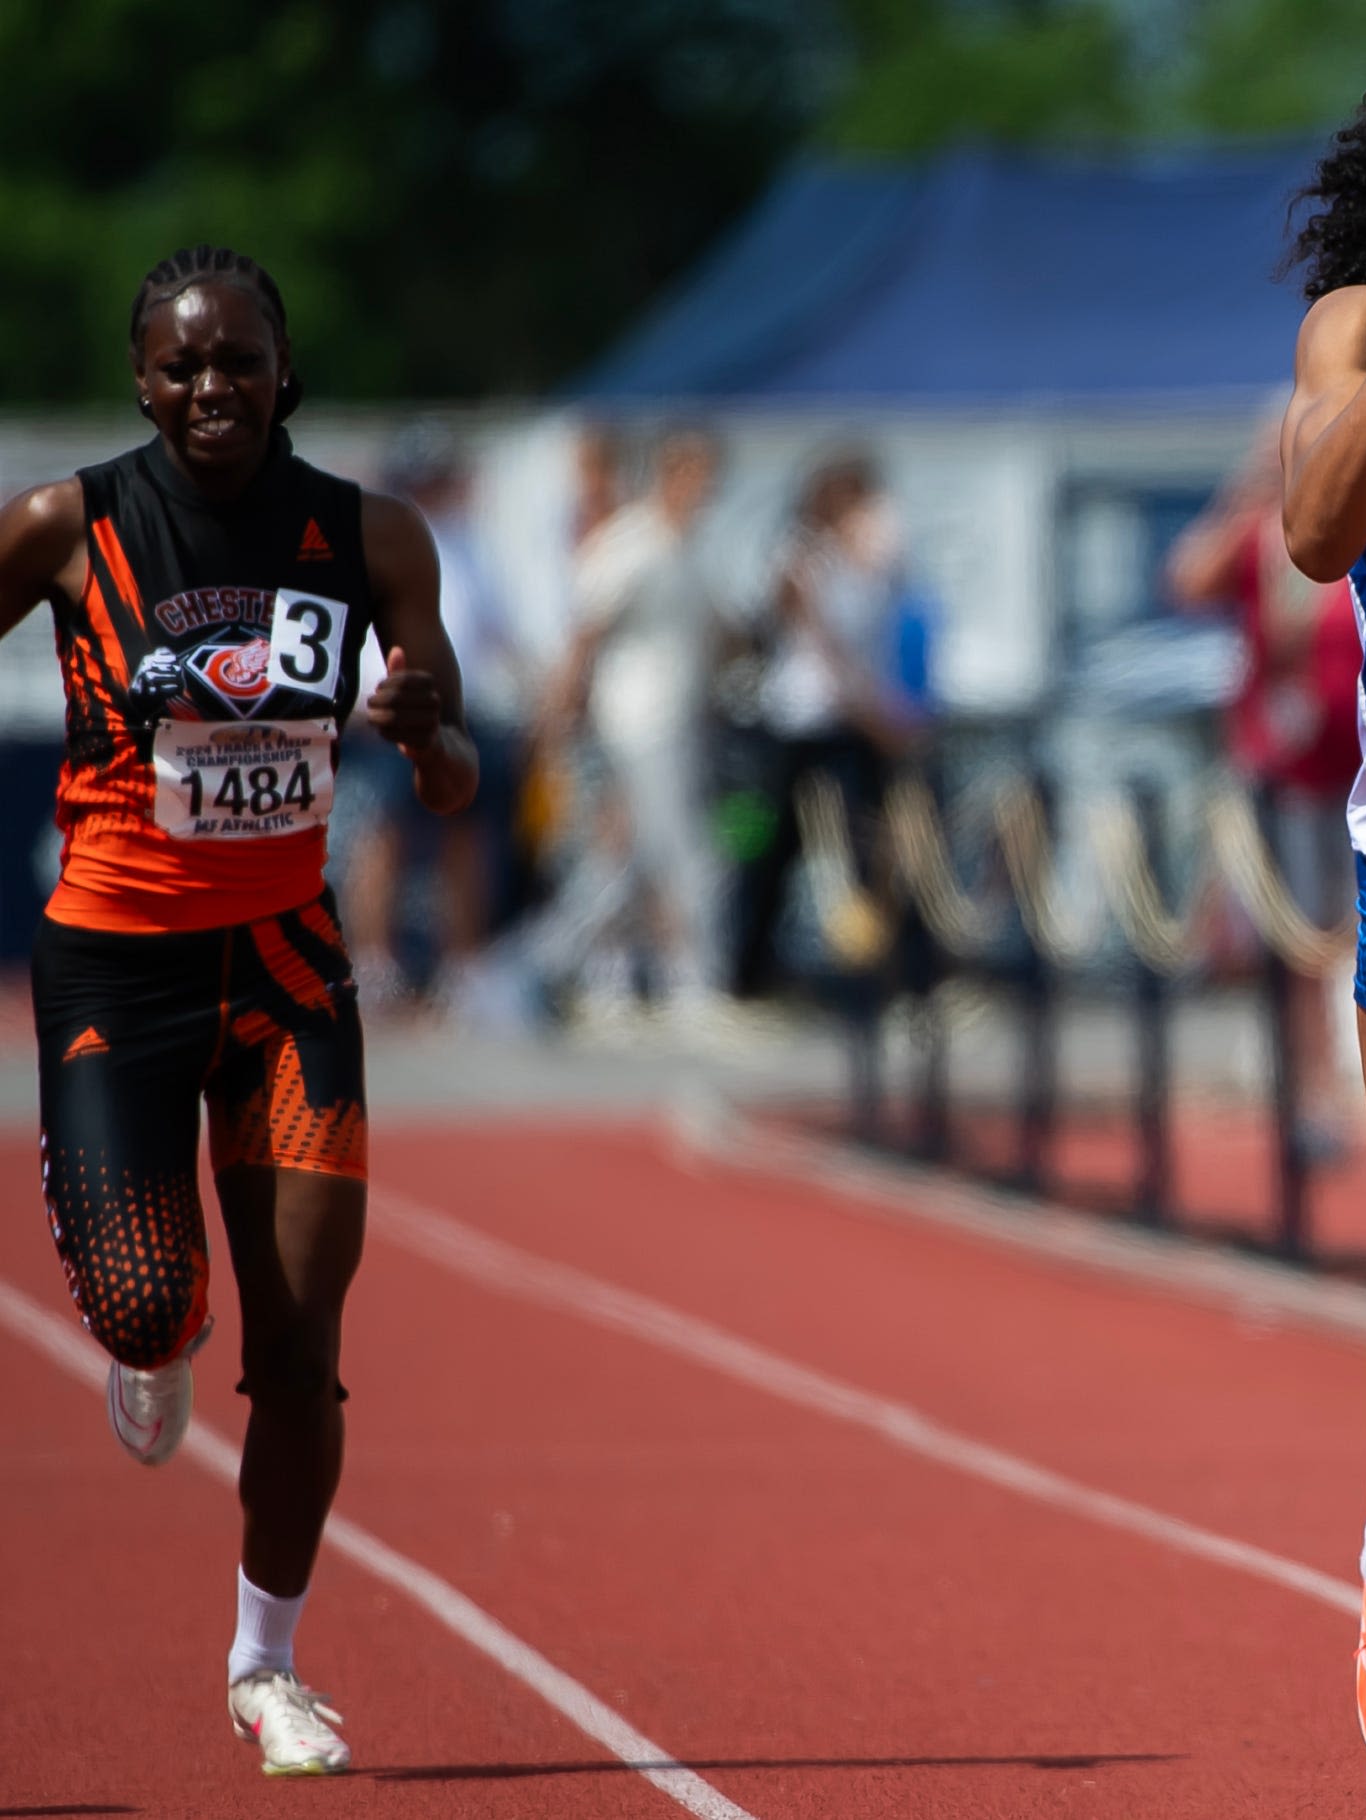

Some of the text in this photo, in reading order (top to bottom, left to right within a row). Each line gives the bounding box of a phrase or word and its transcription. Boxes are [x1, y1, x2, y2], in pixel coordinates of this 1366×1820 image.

[154, 586, 277, 637] CHESTE
[279, 600, 333, 684] 3
[180, 760, 316, 817] 1484
[221, 811, 295, 832] ATHLETIC
